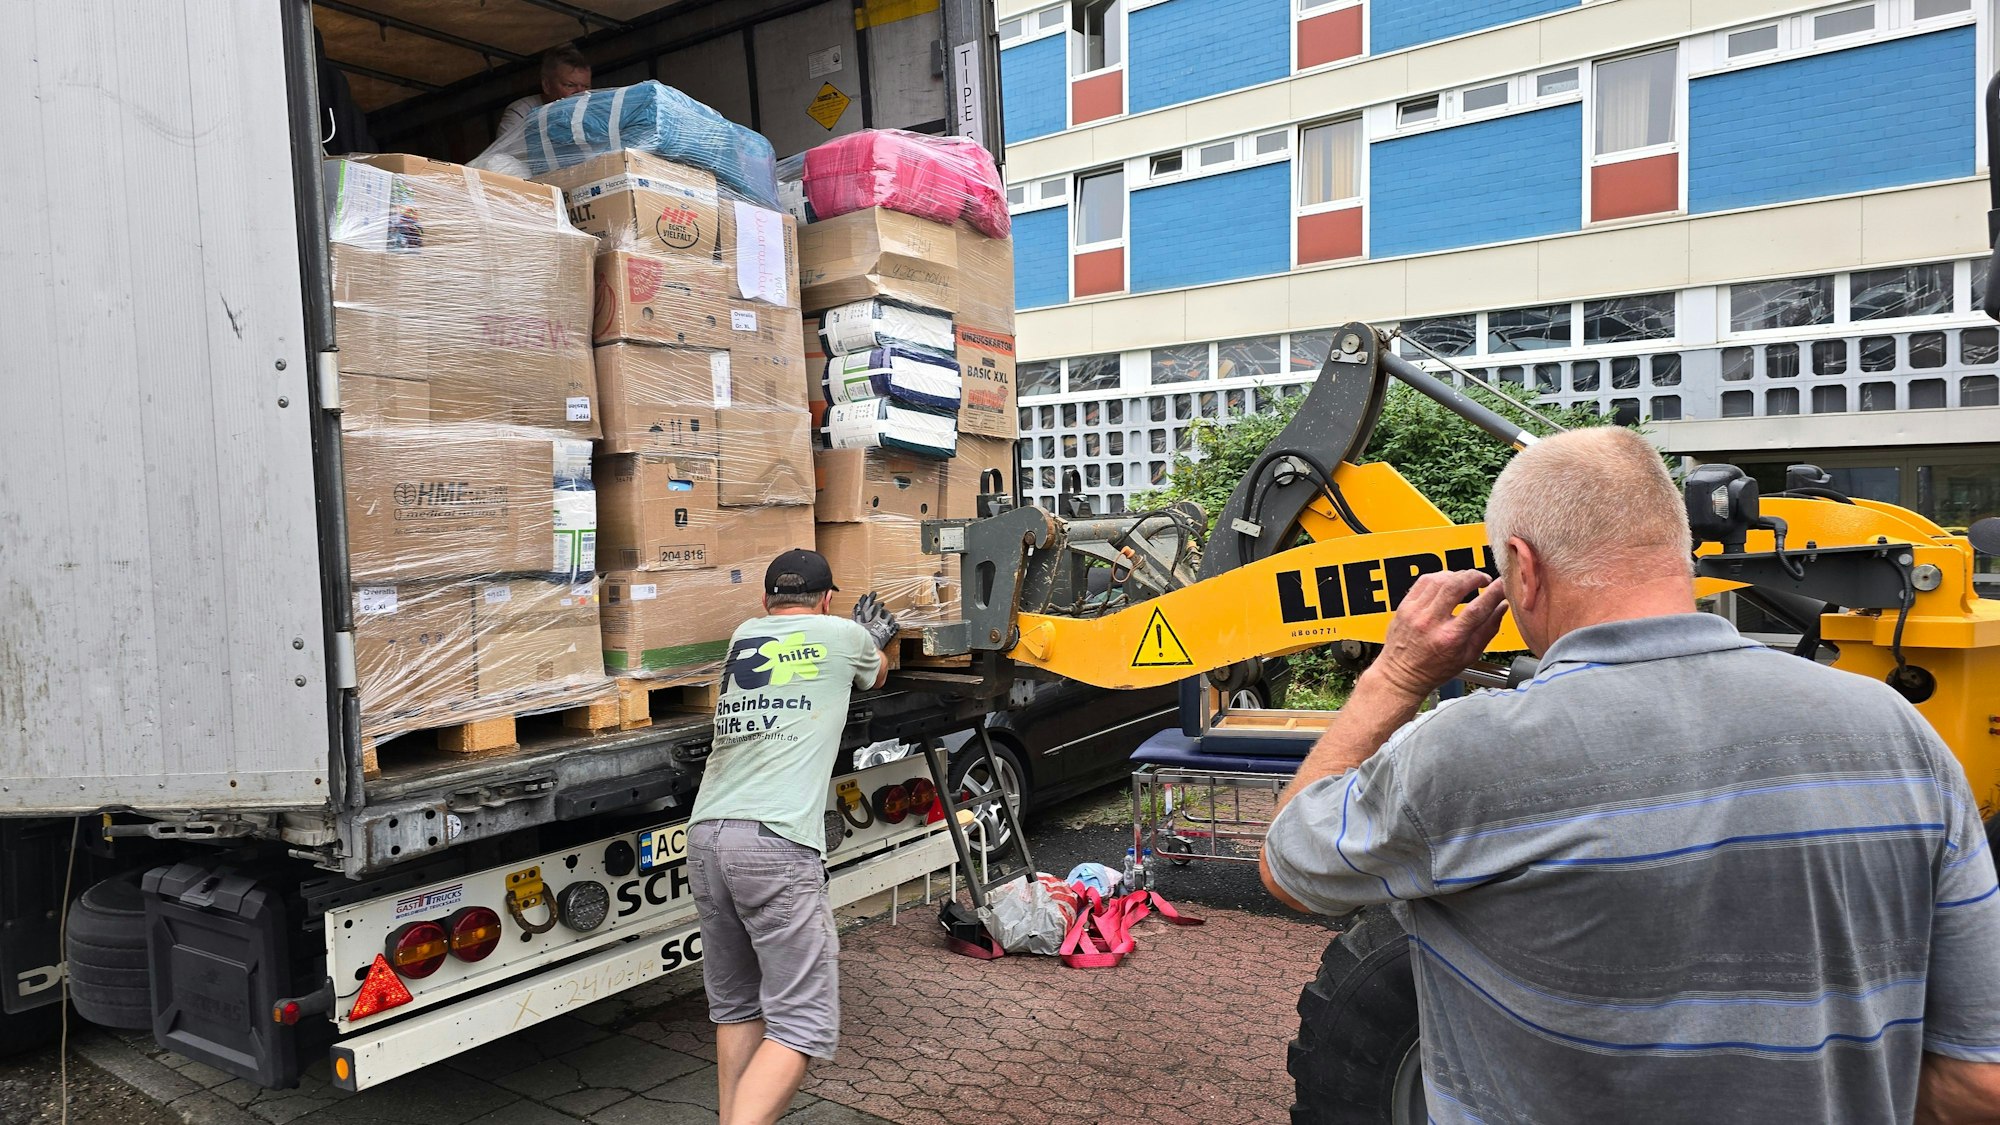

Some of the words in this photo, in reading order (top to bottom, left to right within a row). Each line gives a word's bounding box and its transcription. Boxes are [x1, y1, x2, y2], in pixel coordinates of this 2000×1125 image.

[661, 206, 698, 227] HIT
[668, 223, 687, 232] ECHTE
[967, 365, 991, 380] BASIC
[994, 371, 1009, 384] XXL
[677, 511, 685, 524] 7
[661, 551, 681, 562] 204
[683, 549, 705, 561] 818
[778, 647, 820, 663] hilft
[717, 694, 812, 716] Rheinbach
[746, 719, 760, 732] e.
[762, 715, 780, 730] V.
[656, 829, 685, 860] AC
[642, 854, 652, 864] UA
